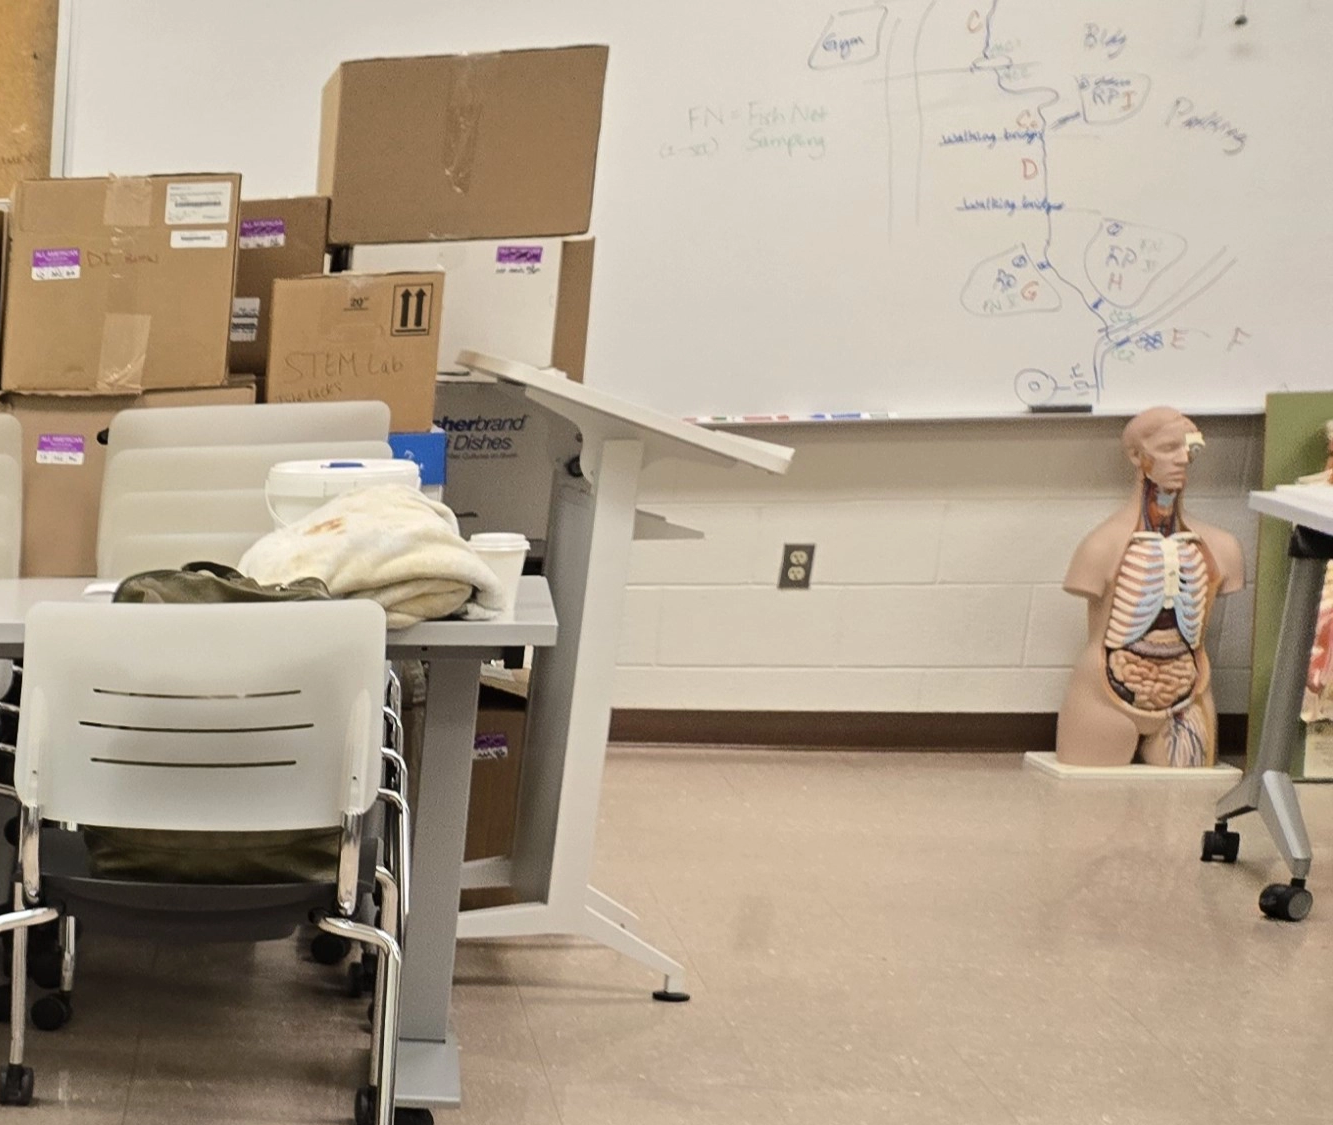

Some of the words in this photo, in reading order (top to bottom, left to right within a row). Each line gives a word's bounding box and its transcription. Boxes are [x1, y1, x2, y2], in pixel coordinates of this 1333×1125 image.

[1021, 157, 1039, 181] D
[284, 352, 358, 385] STEM
[433, 414, 529, 432] herbrand
